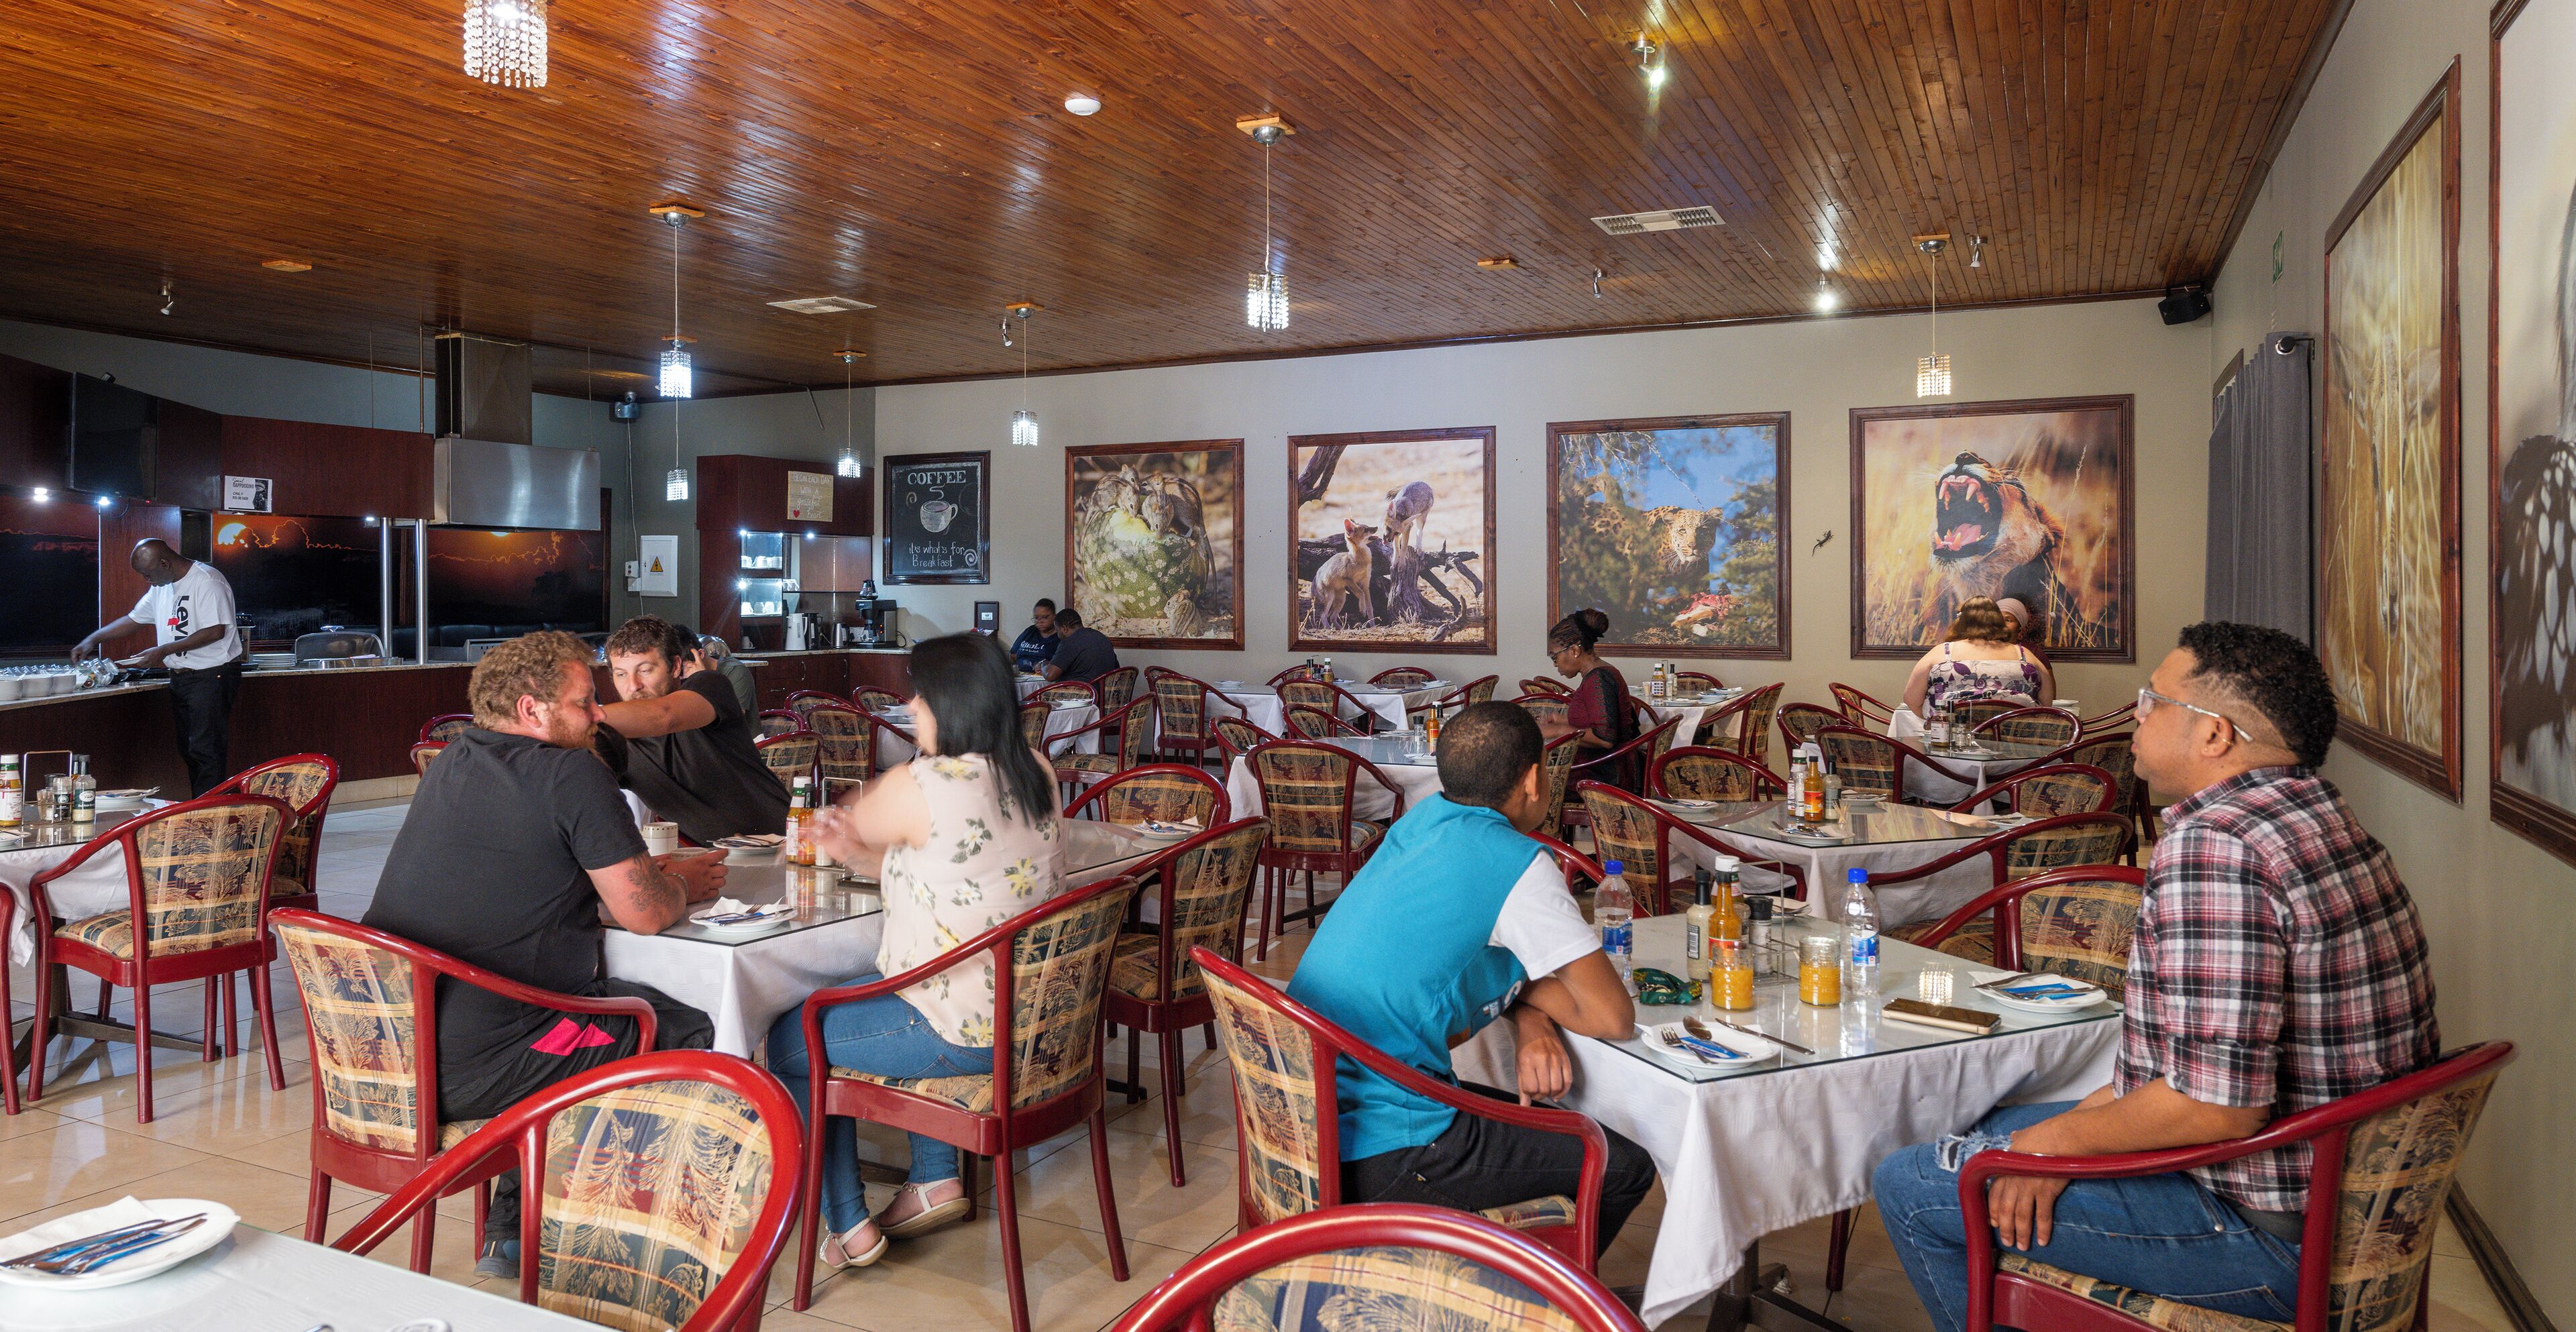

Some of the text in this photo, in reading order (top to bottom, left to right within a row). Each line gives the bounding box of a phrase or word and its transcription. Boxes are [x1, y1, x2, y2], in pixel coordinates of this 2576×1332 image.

[907, 470, 967, 485] COFFEE
[951, 541, 965, 555] for
[912, 554, 953, 567] Breakfast
[174, 595, 190, 657] Lev
